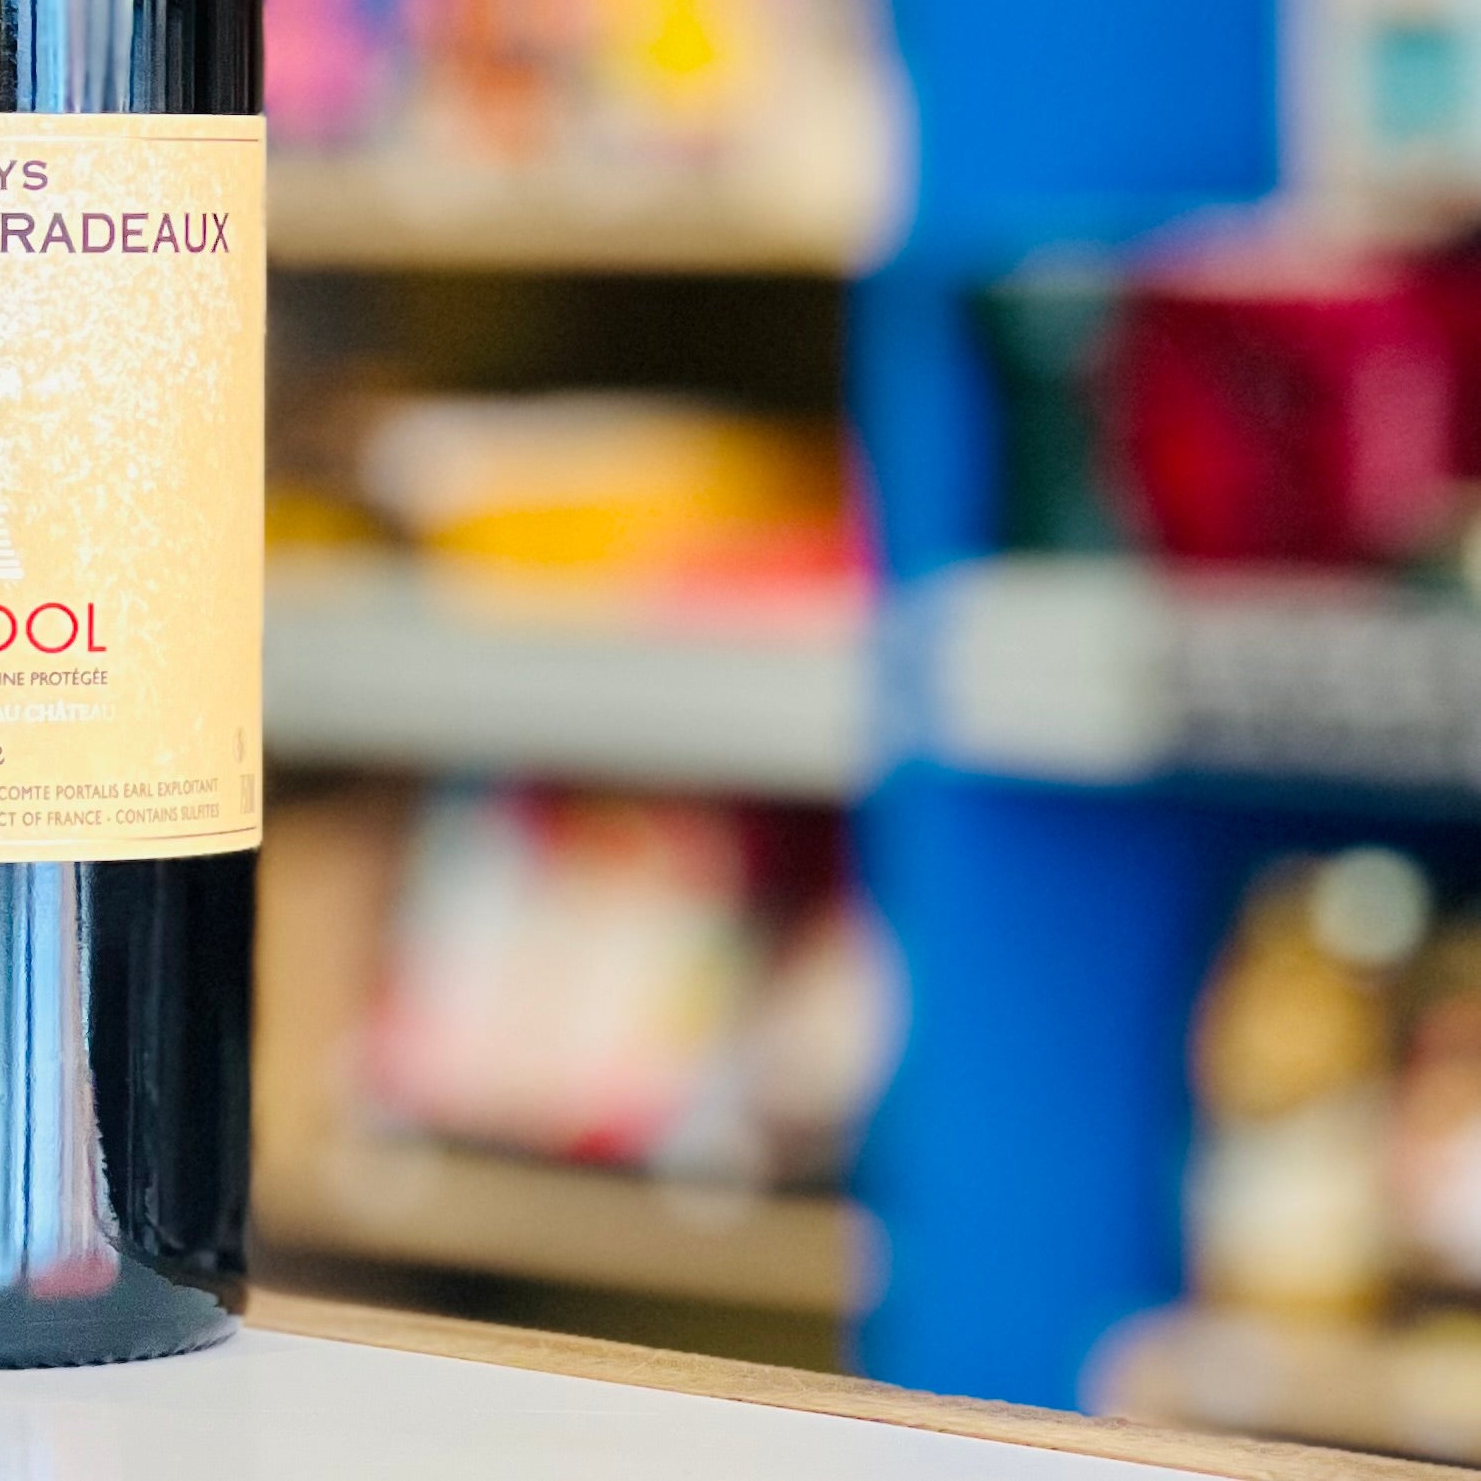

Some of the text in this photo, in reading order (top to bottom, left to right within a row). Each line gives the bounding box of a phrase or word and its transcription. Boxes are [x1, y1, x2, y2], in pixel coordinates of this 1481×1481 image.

[30, 667, 108, 686] PROTÉGÉE
[56, 782, 119, 801] PORTALIS
[123, 781, 153, 799] EARL
[157, 777, 219, 798] EXPLOITANT
[21, 811, 41, 827] OF
[46, 810, 102, 826] FRANCE
[115, 806, 179, 825] CONTAINS
